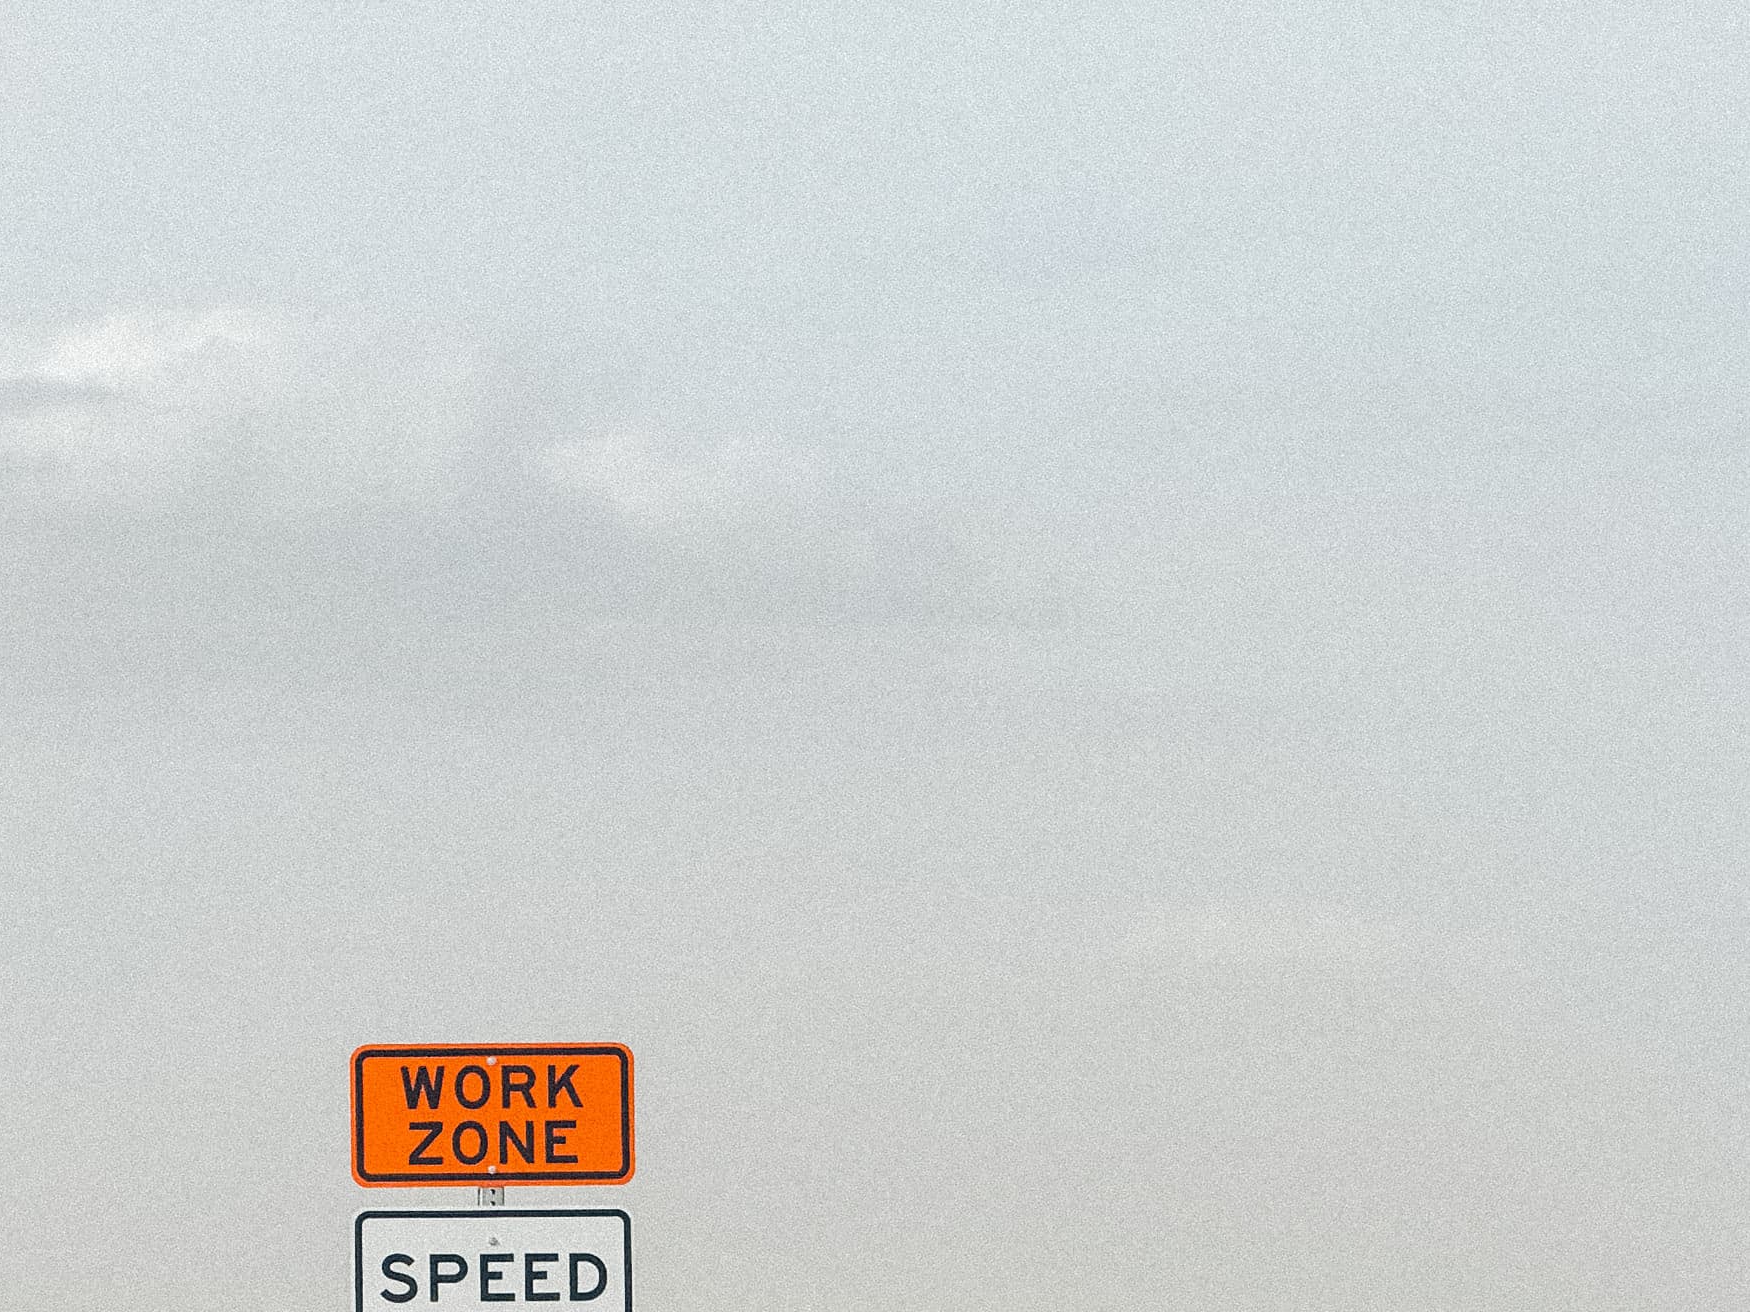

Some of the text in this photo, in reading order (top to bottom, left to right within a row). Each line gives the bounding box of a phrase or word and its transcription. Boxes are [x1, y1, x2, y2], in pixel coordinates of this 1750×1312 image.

[400, 1064, 584, 1110] WORK
[408, 1119, 579, 1166] ZONE
[379, 1252, 608, 1304] SPEED
